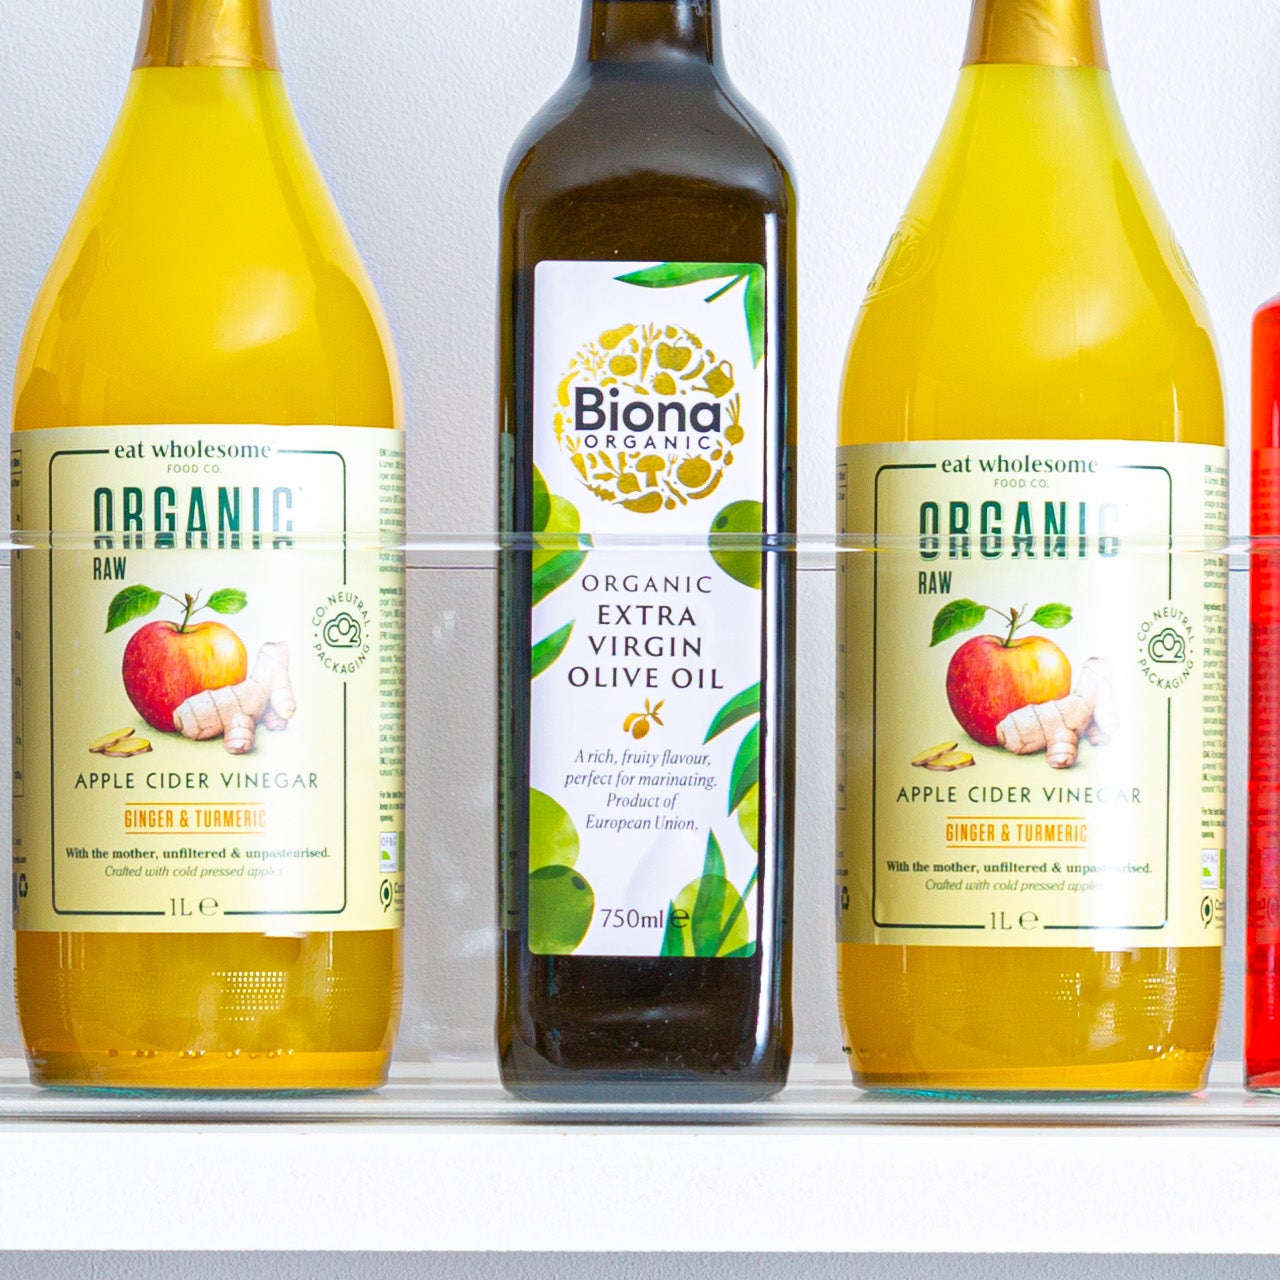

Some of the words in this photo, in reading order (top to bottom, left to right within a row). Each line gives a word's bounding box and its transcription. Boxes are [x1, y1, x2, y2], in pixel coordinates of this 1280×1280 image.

[574, 387, 721, 433] Biona
[114, 442, 143, 459] eat
[151, 440, 272, 459] wholesome
[584, 435, 711, 449] ORGANIC
[167, 464, 199, 474] FOOD
[204, 464, 222, 474] CO.
[941, 456, 971, 473] eat
[979, 455, 1098, 473] wholesome
[94, 486, 295, 549] ORGANIC
[93, 557, 126, 581] RAW
[581, 575, 713, 593] ORGANIC
[598, 605, 697, 626] EXTRA
[588, 636, 702, 657] VIRGIN
[568, 667, 659, 689] OLIVE
[671, 668, 724, 689] OIL
[589, 751, 618, 767] rich,
[622, 751, 658, 768] fruity
[662, 751, 711, 768] flavour,
[75, 773, 135, 790] APPLE
[146, 773, 209, 789] CIDER
[221, 773, 318, 789] VINEGAR
[565, 772, 611, 789] perfect
[615, 772, 634, 789] for
[638, 772, 718, 789] marinating.
[125, 809, 174, 828] GINGER
[180, 809, 190, 828] &
[196, 809, 267, 828] TURMERIC
[65, 848, 88, 859] With
[92, 848, 109, 859] the
[112, 849, 159, 860] mother,
[163, 848, 226, 859] unfiltered
[170, 898, 192, 916] 1L
[601, 908, 664, 929] 750ml
